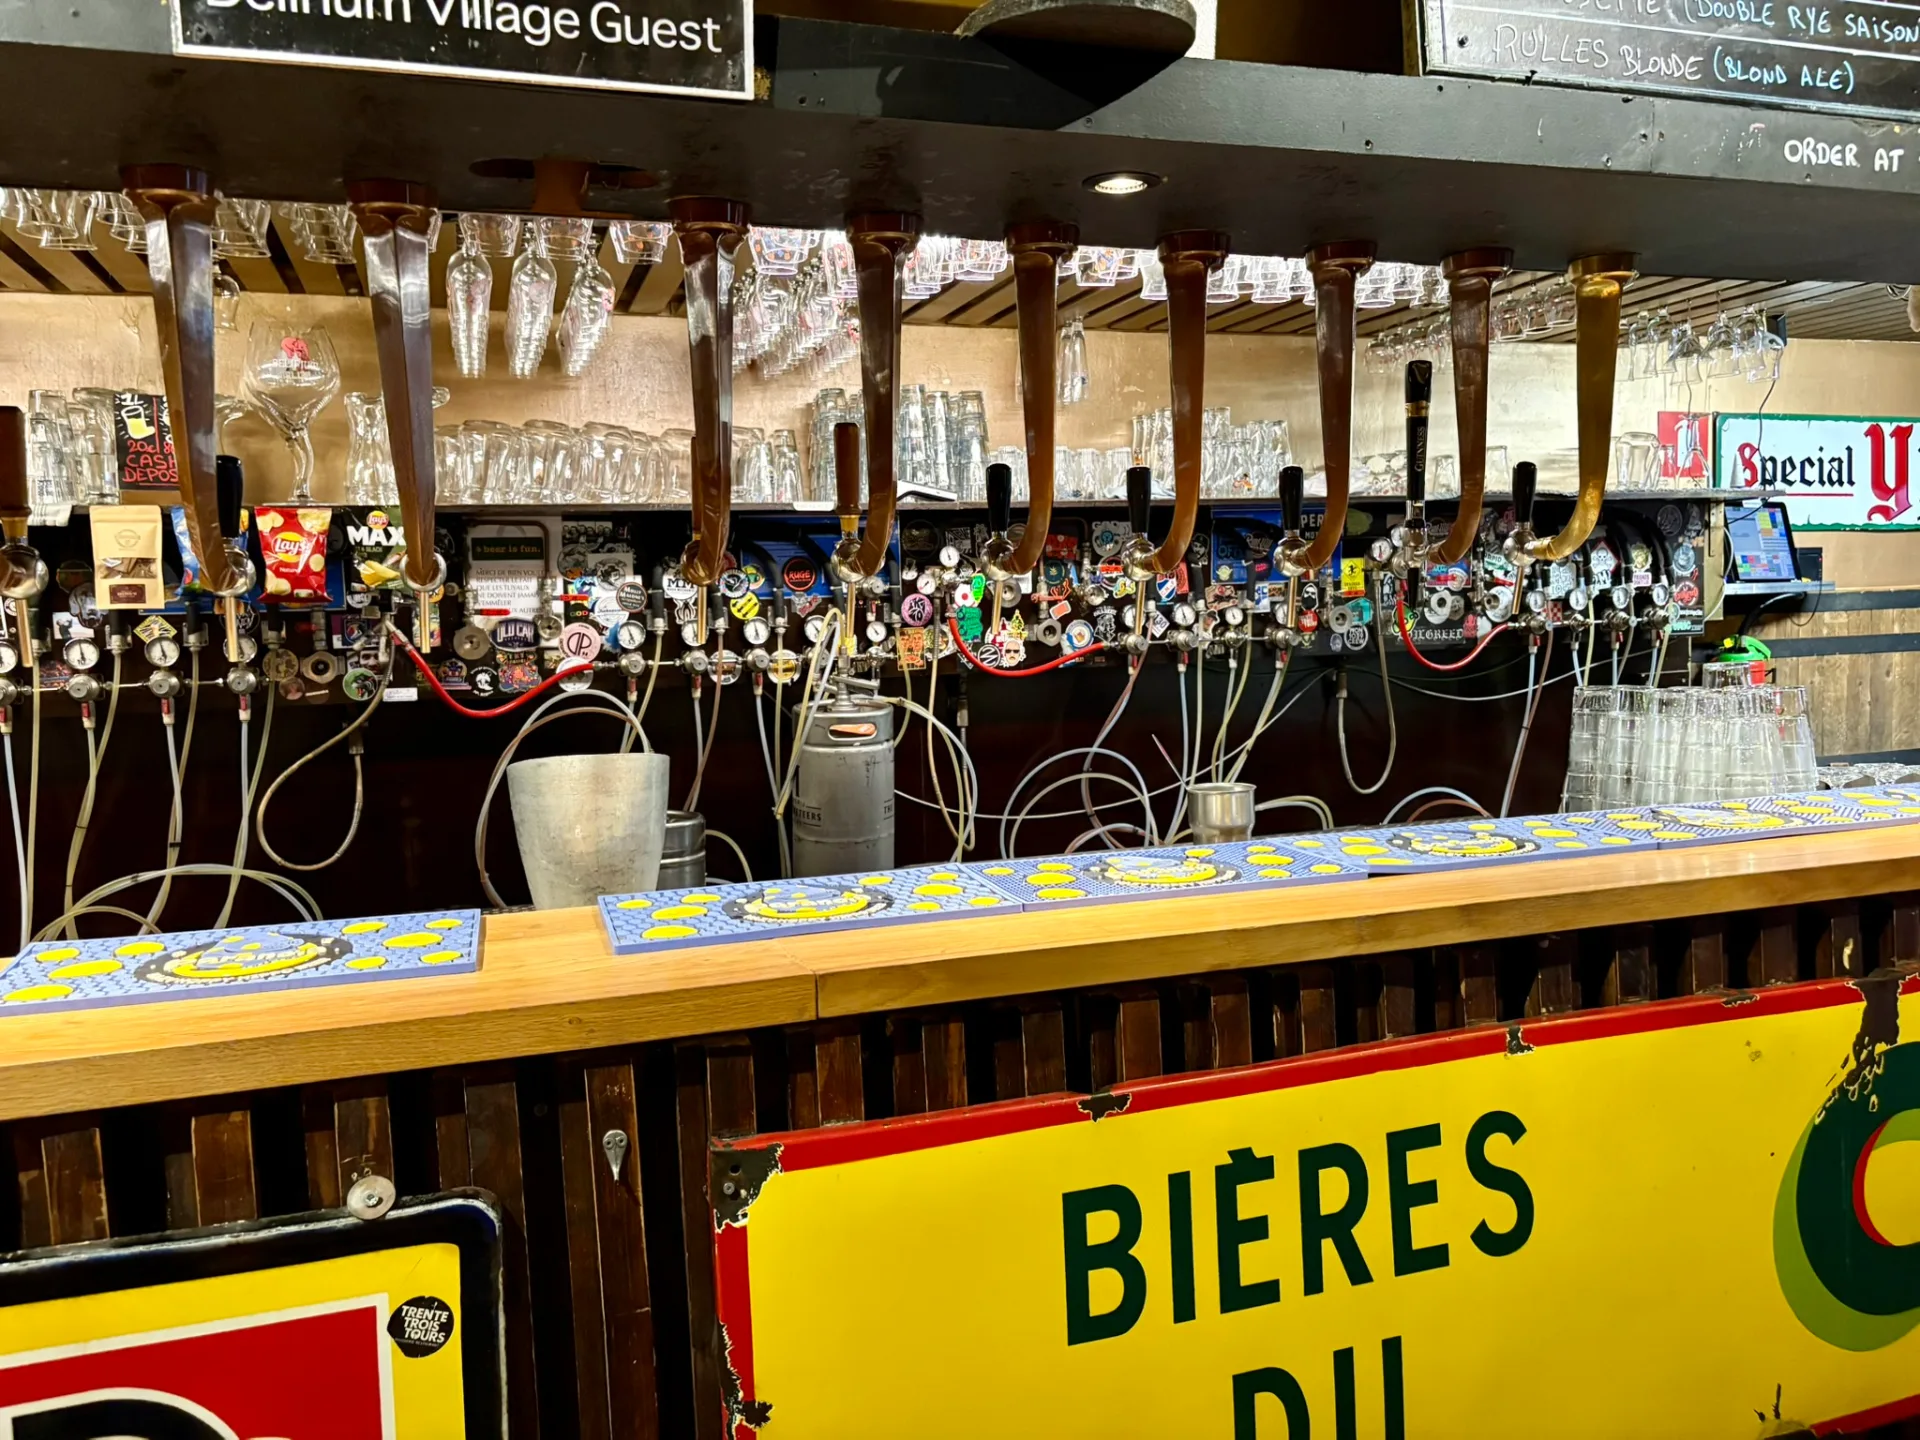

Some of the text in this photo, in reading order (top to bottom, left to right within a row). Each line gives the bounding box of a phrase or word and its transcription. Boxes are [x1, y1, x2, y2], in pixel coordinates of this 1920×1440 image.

[207, 0, 722, 53] rium Village Guest
[1788, 6, 1831, 35] RYE
[1493, 23, 1609, 68] RULLES
[1801, 60, 1855, 94] ALE)
[1784, 137, 1904, 172] ORDER AT
[122, 467, 178, 482] DEPOS
[1737, 423, 1920, 522] Special Y
[401, 1305, 450, 1323] TRENTE
[403, 1316, 441, 1332] TROIS
[404, 1327, 446, 1344] TOURS
